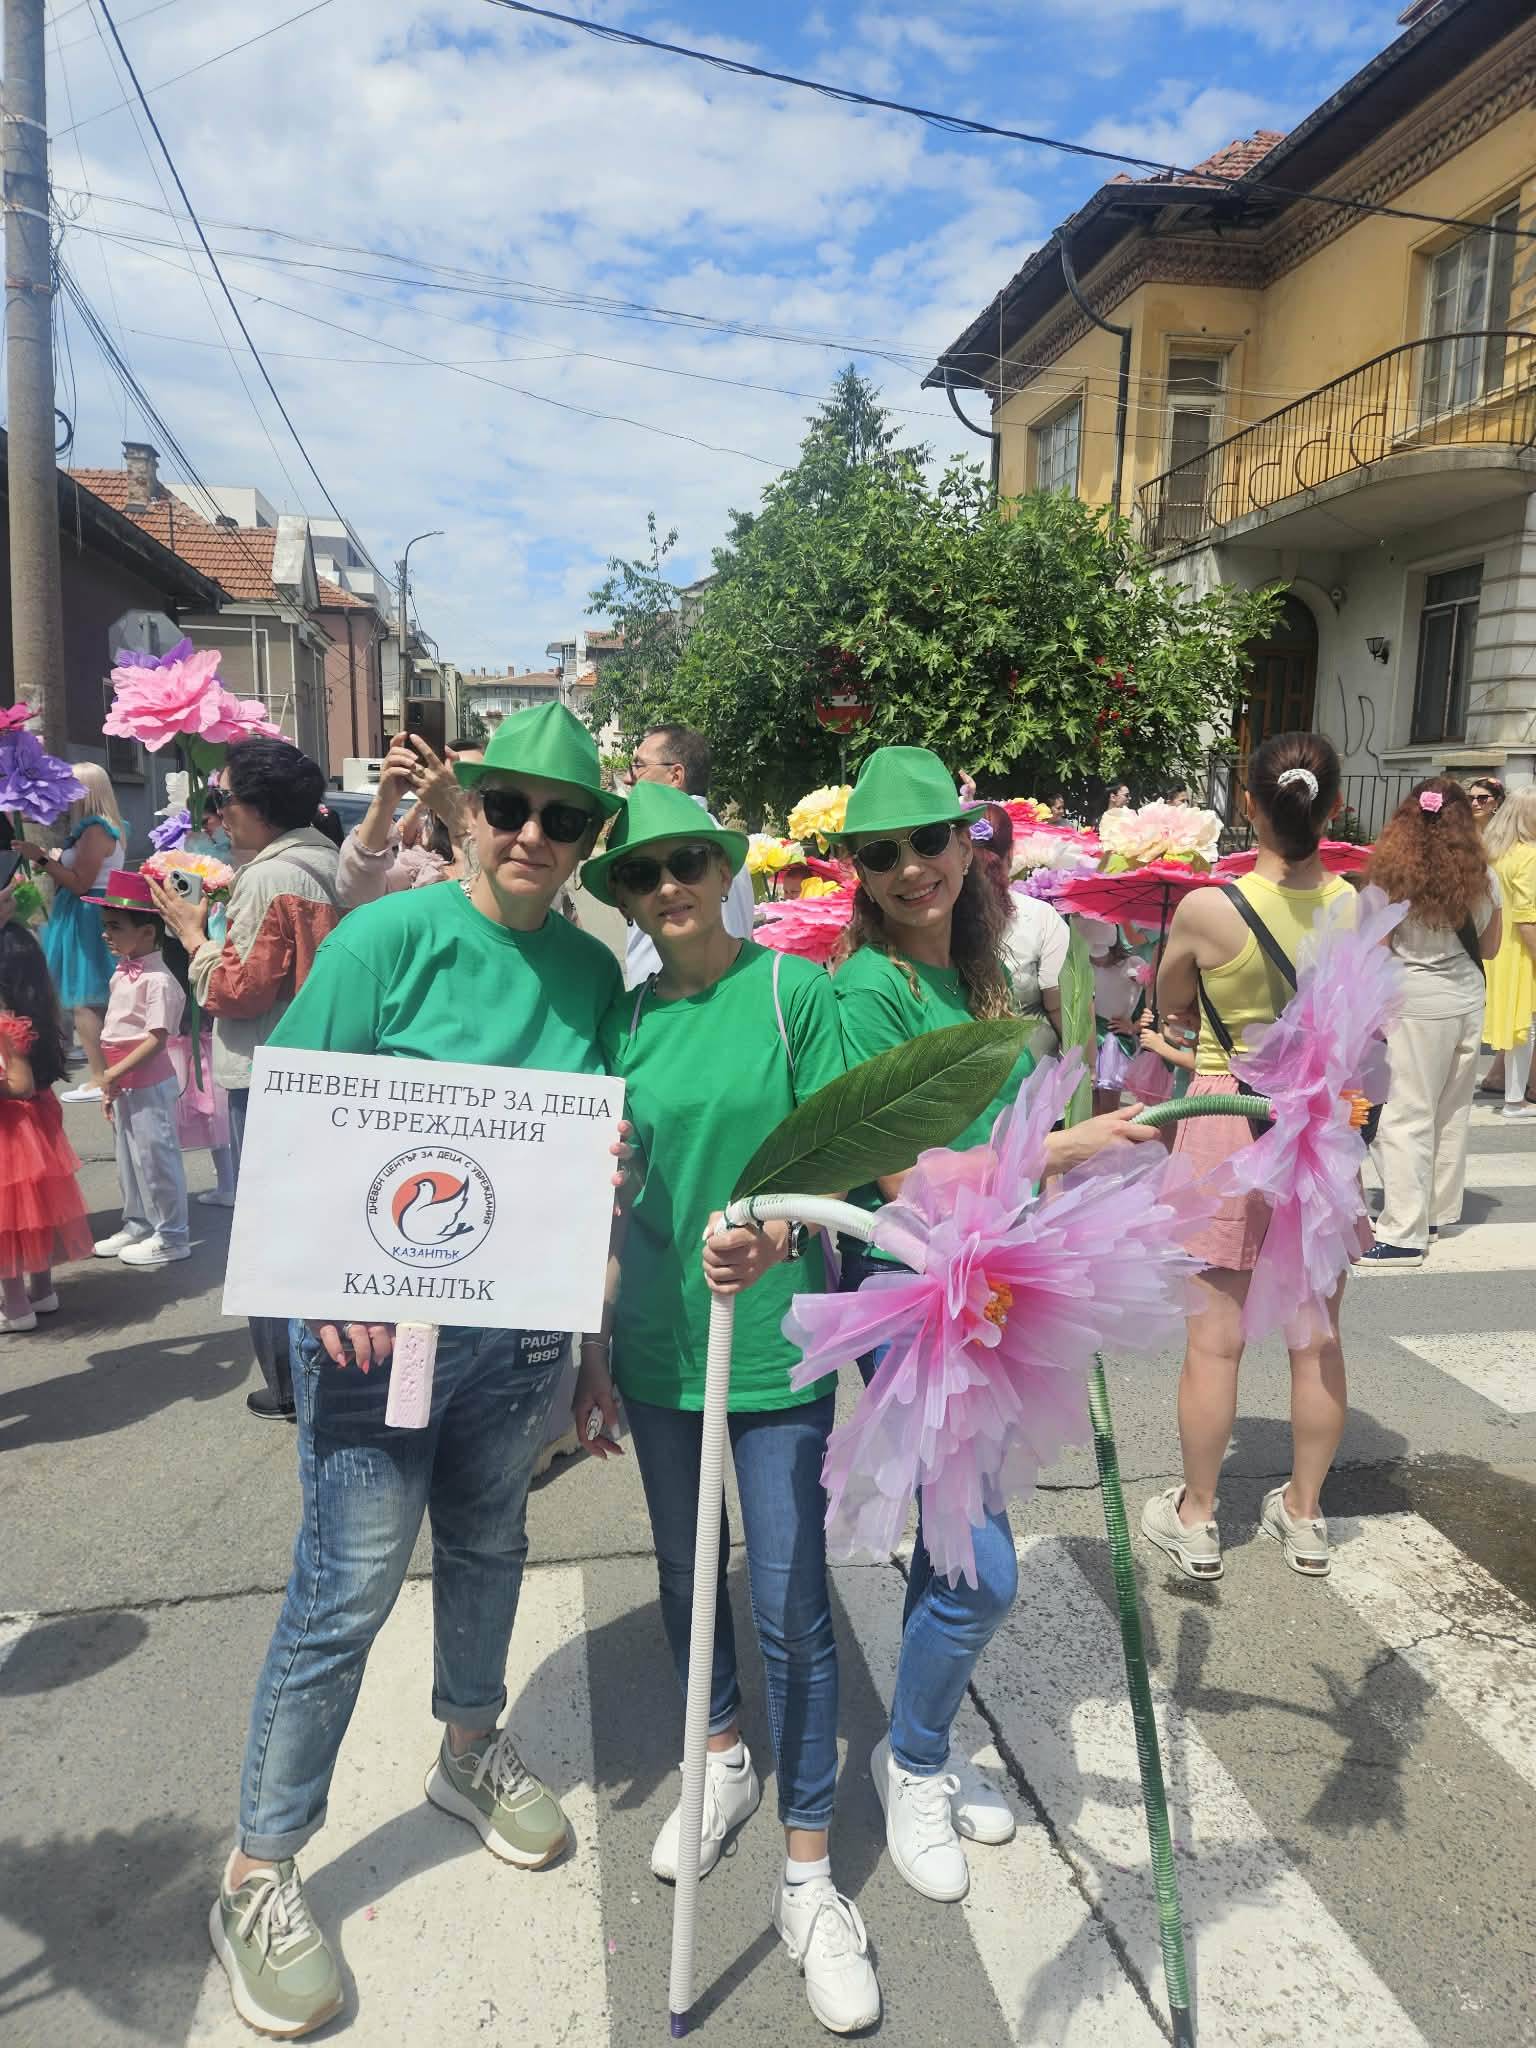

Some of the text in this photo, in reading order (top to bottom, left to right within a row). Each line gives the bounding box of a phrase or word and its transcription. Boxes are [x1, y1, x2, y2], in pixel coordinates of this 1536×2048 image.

[264, 1070, 612, 1120] ДНЕВЕН ЦЕНТЪР ЗА ДЕЦА
[331, 1107, 547, 1143] С УВРЕЖДАНИЯ
[368, 1178, 385, 1215] ДНЕВЕН
[383, 1153, 417, 1178] ЦЕНТЪР
[421, 1151, 433, 1159] ЗА
[437, 1150, 462, 1164] ДЕЦА
[471, 1166, 494, 1225] УВРЕЖДАНИЯ
[343, 1272, 496, 1301] КАЗАНЛЪК
[526, 1347, 560, 1365] 1999
